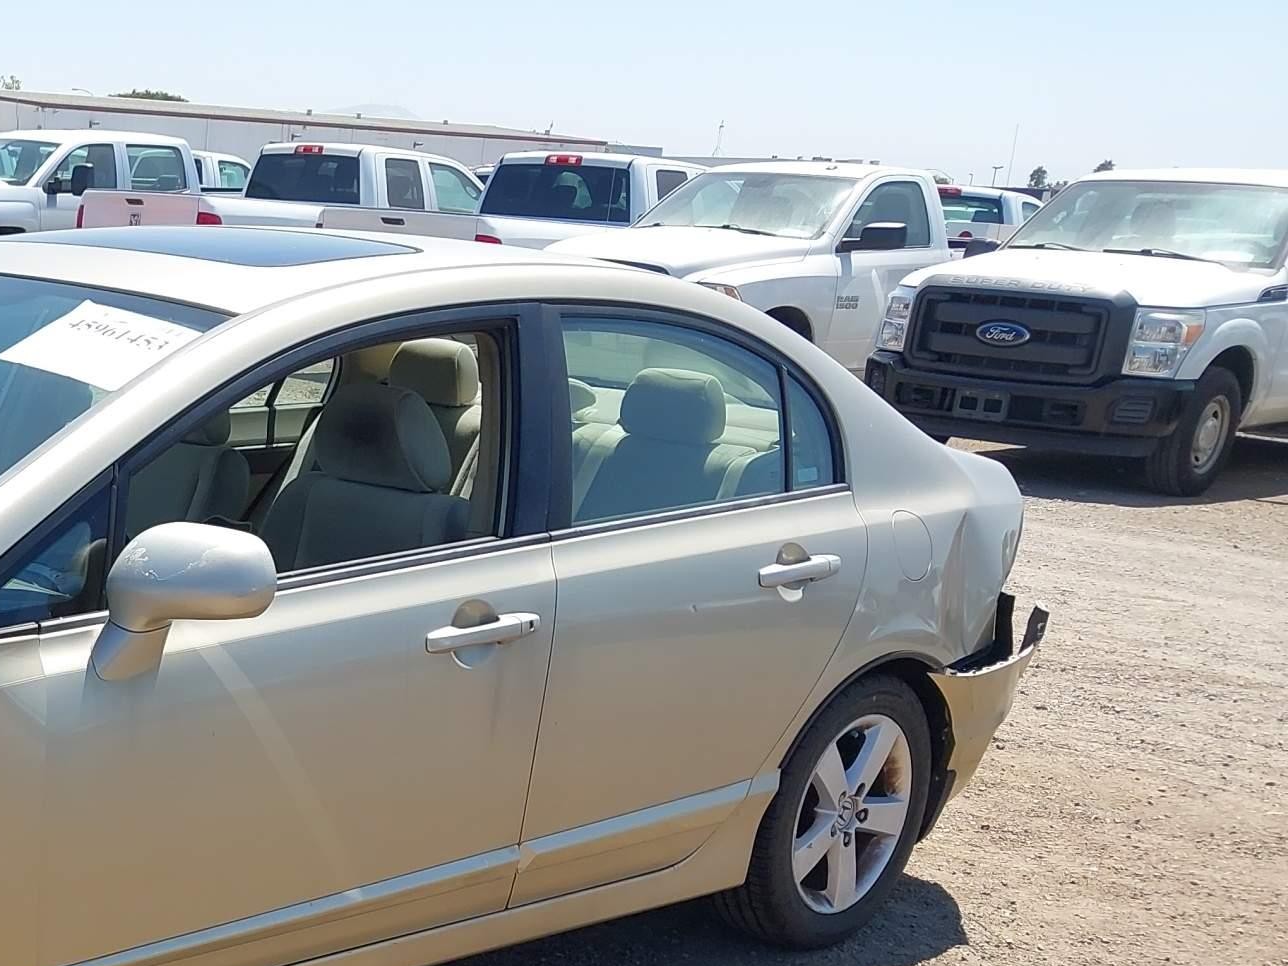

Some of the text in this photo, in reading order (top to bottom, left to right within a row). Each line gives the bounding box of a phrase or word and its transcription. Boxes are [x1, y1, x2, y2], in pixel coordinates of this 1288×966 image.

[950, 275, 1094, 293] SUPER DUTY
[986, 325, 1016, 342] Ford
